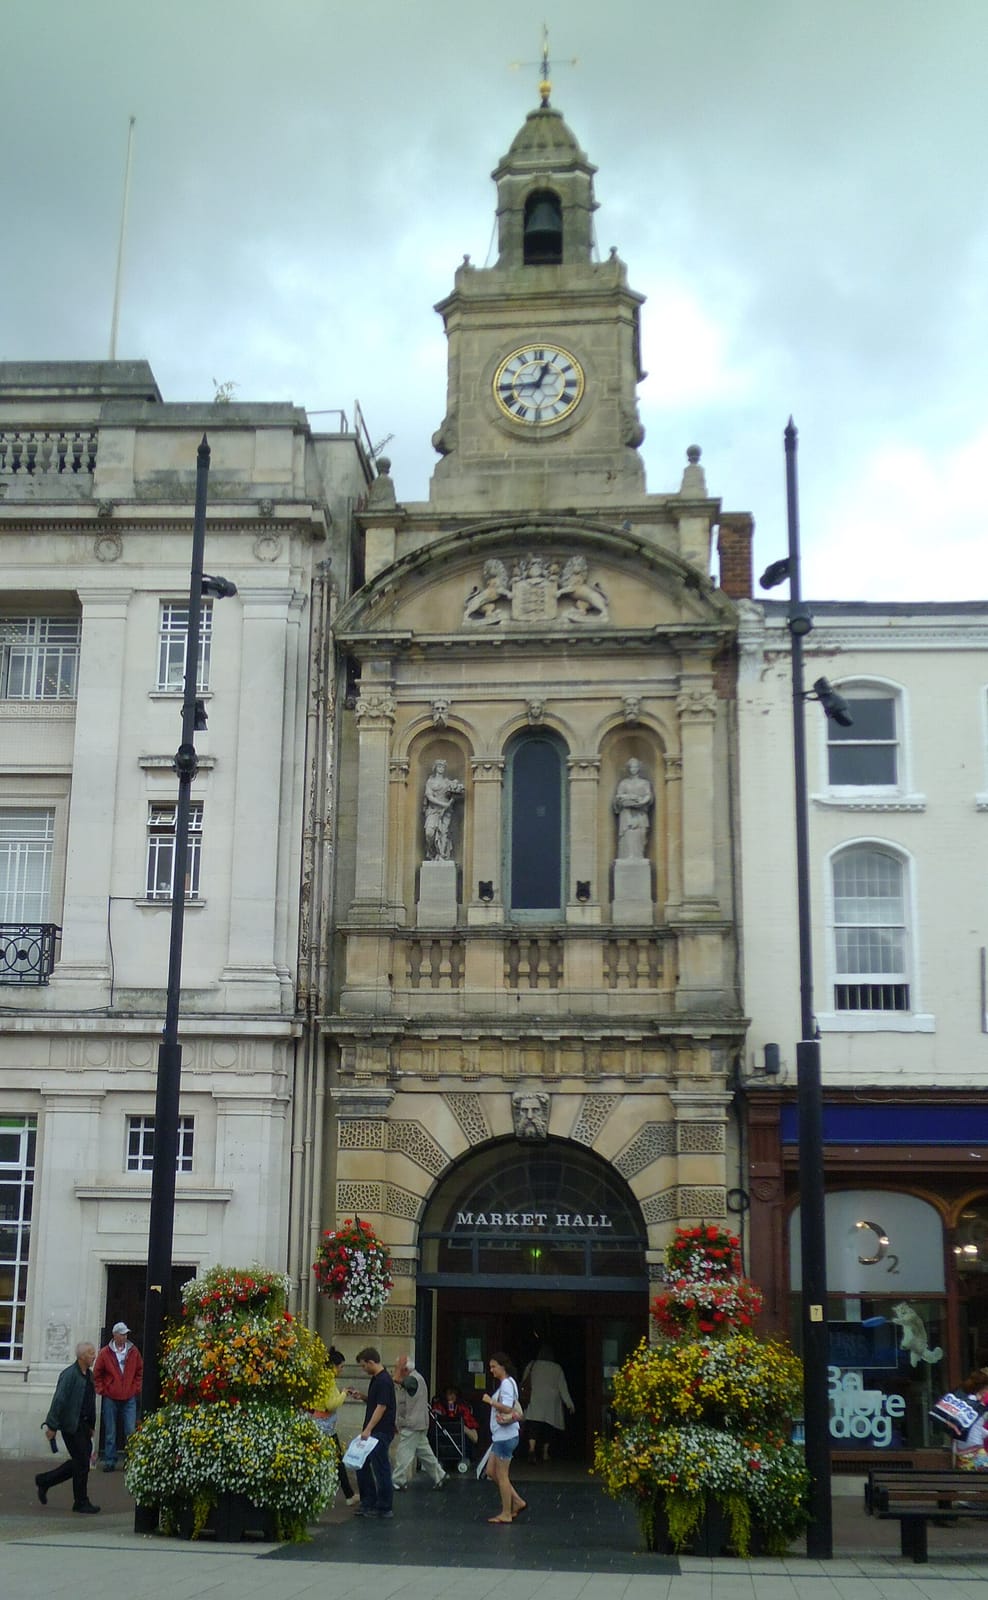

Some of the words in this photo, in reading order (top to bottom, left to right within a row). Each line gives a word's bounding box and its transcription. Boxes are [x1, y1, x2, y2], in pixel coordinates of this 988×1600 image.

[456, 1211, 548, 1226] MARKET
[555, 1213, 612, 1227] HALL
[828, 1411, 892, 1448] dog
